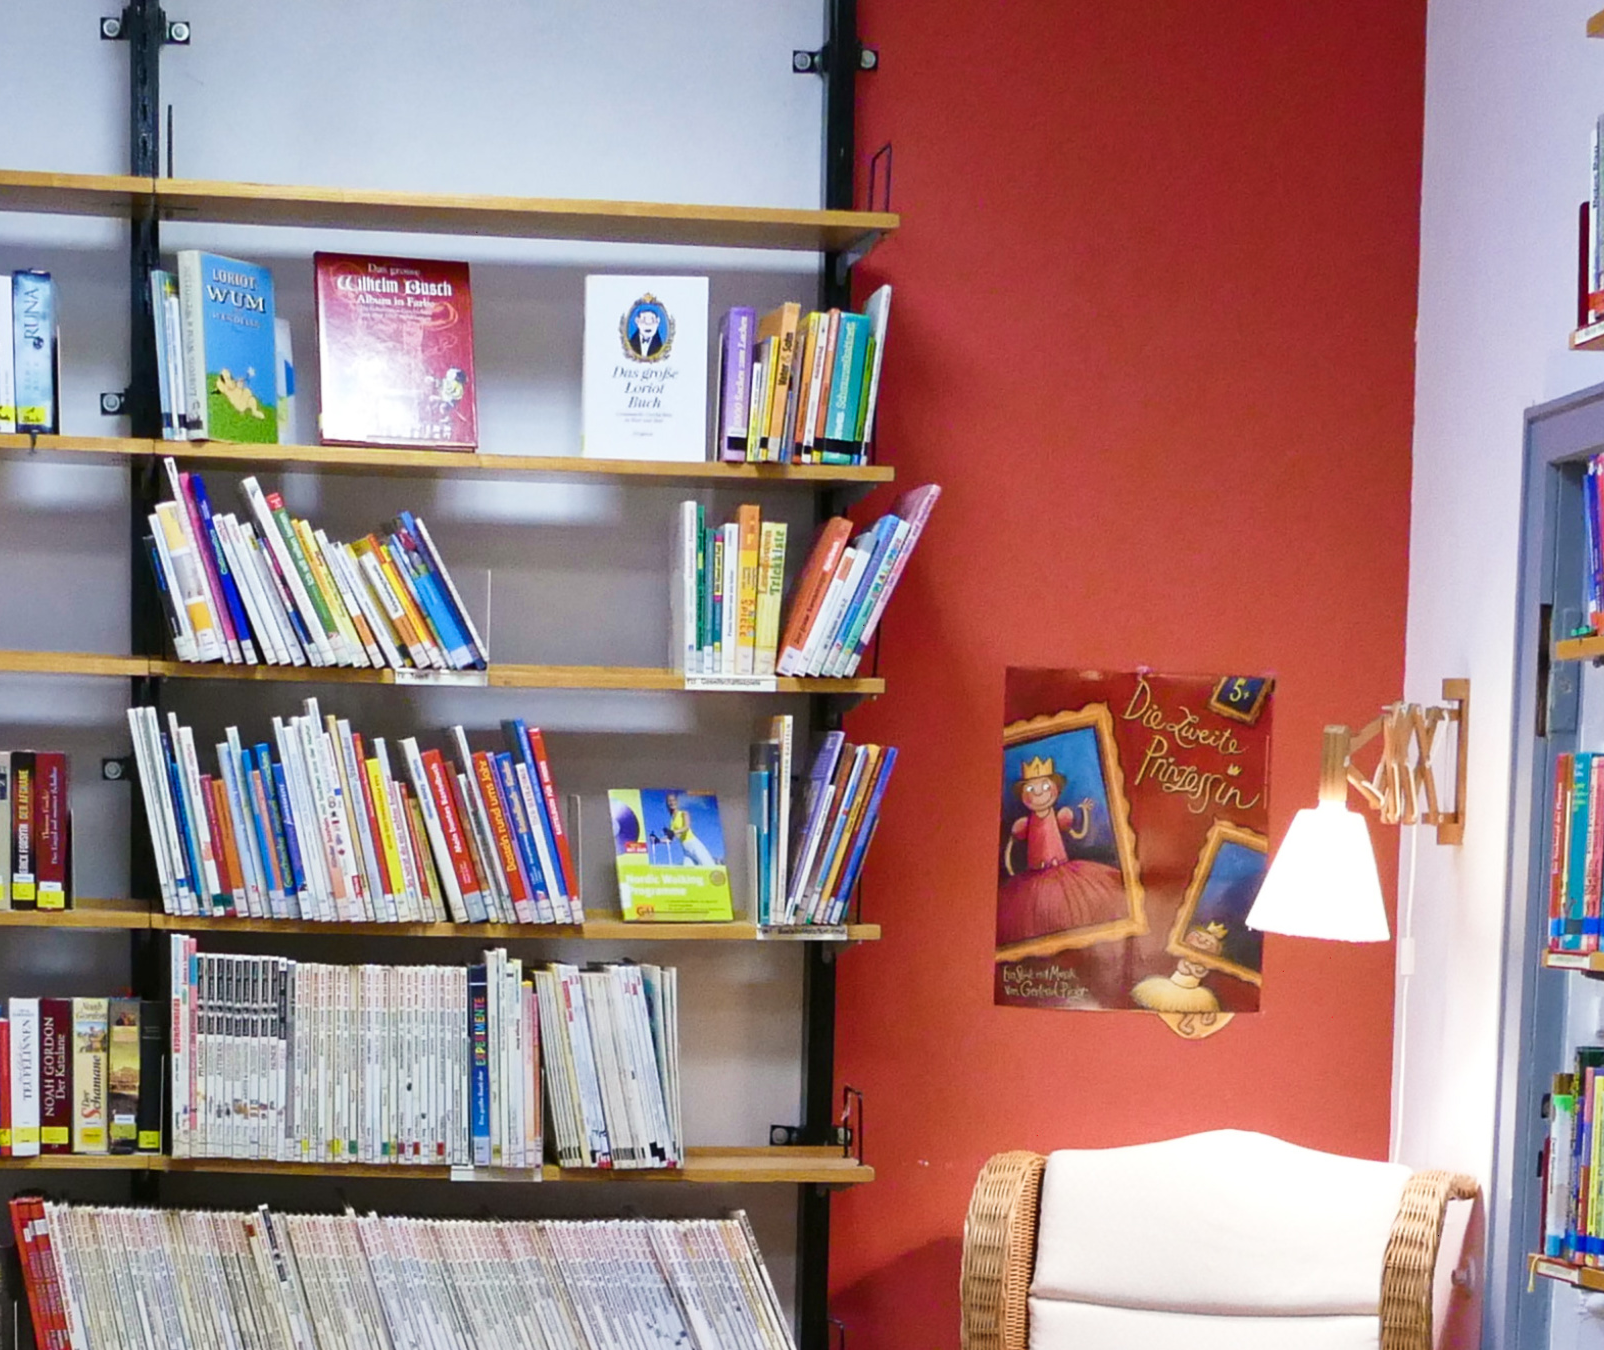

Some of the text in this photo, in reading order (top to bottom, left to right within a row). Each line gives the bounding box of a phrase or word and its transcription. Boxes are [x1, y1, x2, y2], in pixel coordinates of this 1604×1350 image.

[24, 287, 40, 341] RUNA
[207, 285, 265, 313] WUM
[357, 293, 388, 306] Album
[613, 365, 679, 384] Das große
[624, 382, 664, 395] Loriot
[627, 396, 661, 410] Buch
[1121, 676, 1244, 754] Die Zweite
[1135, 735, 1261, 813] Prinzessin
[20, 1018, 33, 1100] TEUFELINNEN
[472, 997, 489, 1066] EXPERIMENTE
[42, 1016, 55, 1117] NOAH GORDON
[54, 1034, 65, 1099] Der Katalane
[81, 1055, 102, 1119] Schamane
